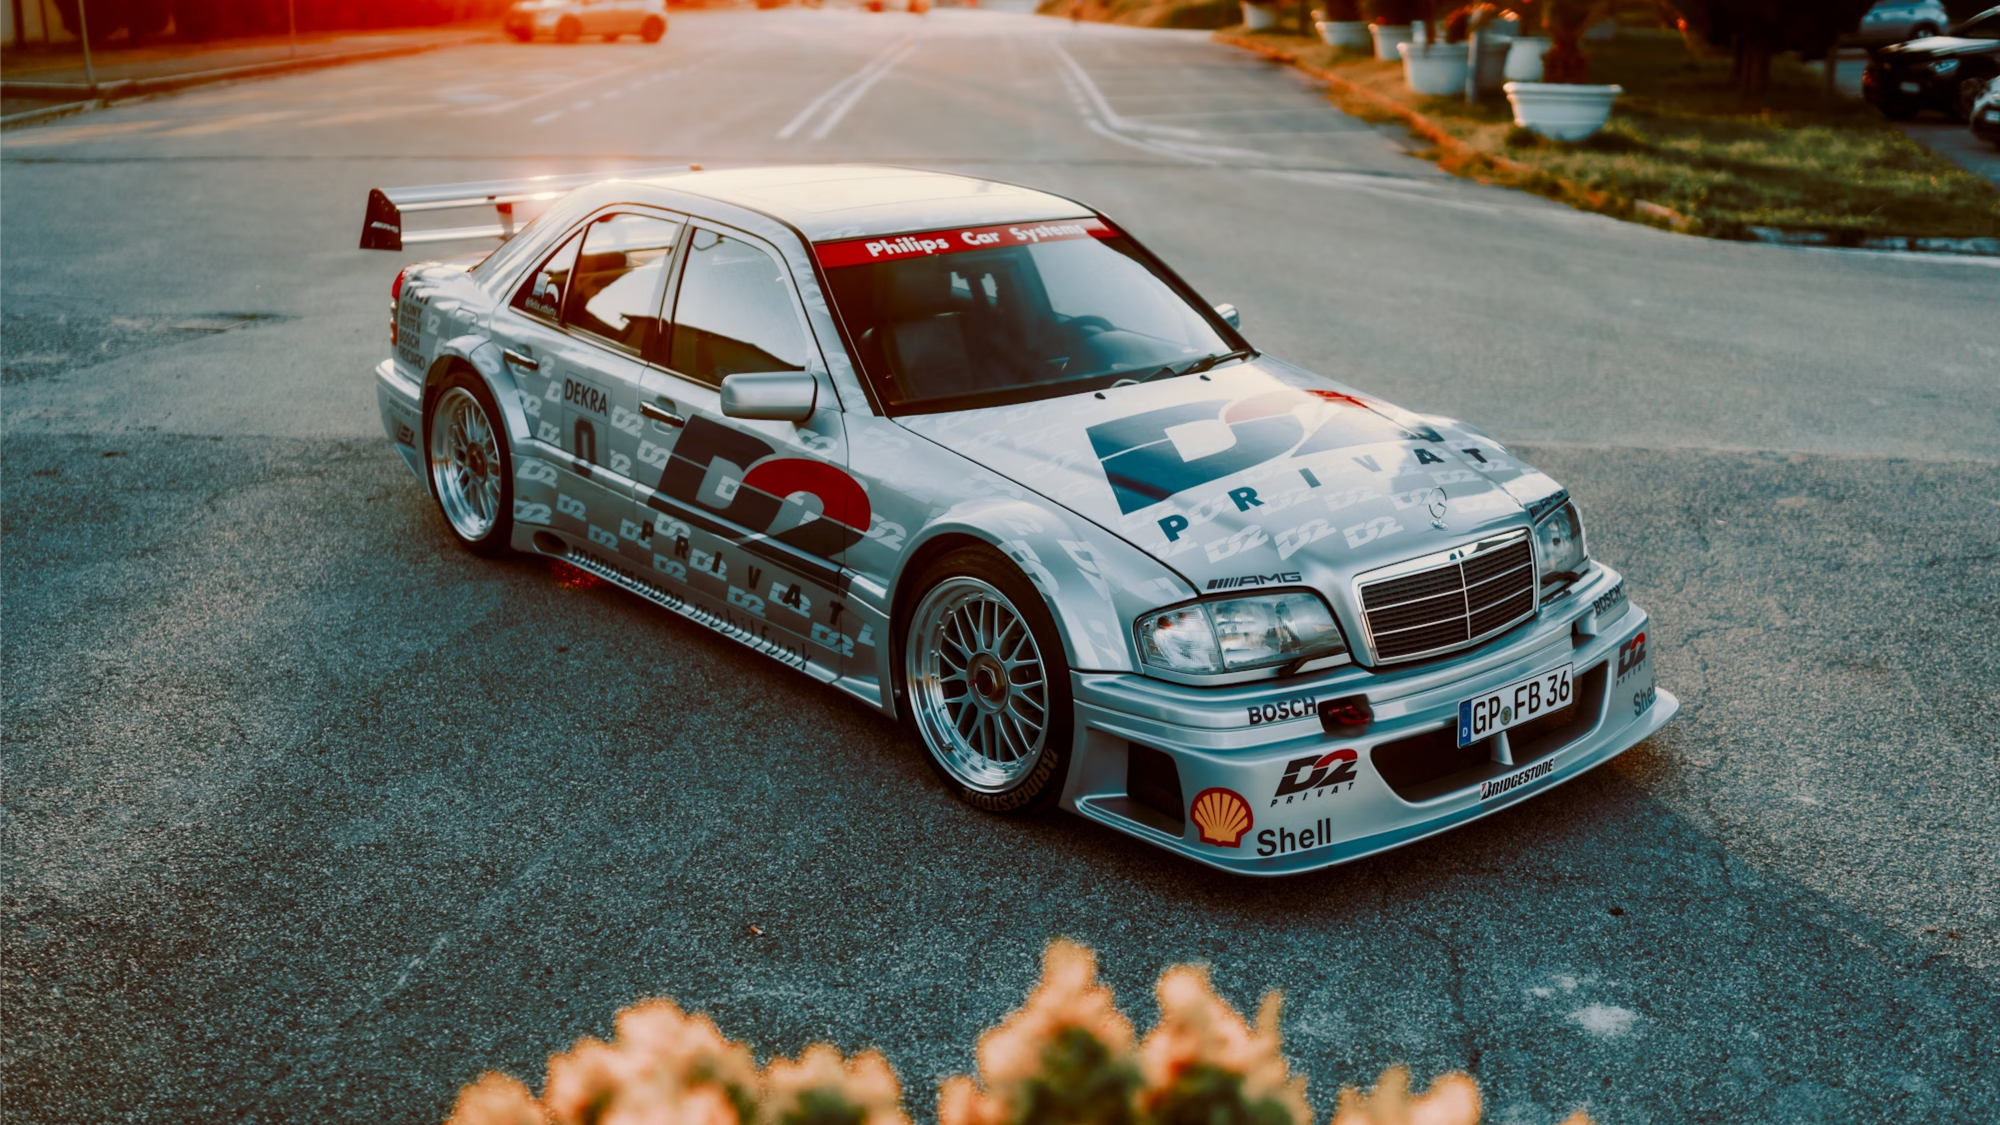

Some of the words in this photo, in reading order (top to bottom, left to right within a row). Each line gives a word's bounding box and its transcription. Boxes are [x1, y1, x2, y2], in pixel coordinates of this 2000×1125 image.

[865, 236, 950, 257] Philips
[960, 231, 1000, 246] Car
[1009, 223, 1088, 243] Systems
[564, 378, 608, 417] DEKRA
[556, 493, 587, 522] D2
[647, 414, 871, 597] D2
[588, 524, 620, 552] D2
[1203, 524, 1269, 564] D2
[1274, 518, 1338, 562] D2
[1342, 516, 1404, 550] D2
[653, 553, 688, 585] D2
[726, 585, 766, 618] D2
[1593, 584, 1622, 616] BOSCH
[810, 622, 854, 658] D2
[1617, 632, 1646, 679] D2
[1247, 696, 1317, 726] BOSCH
[1473, 695, 1500, 735] GP
[1514, 681, 1541, 720] FB
[1546, 670, 1570, 707] 36
[1274, 749, 1358, 797] D2
[1480, 758, 1554, 801] BRIDGESTONE
[1270, 782, 1355, 808] PRIVAT
[1256, 818, 1331, 857] Shell
